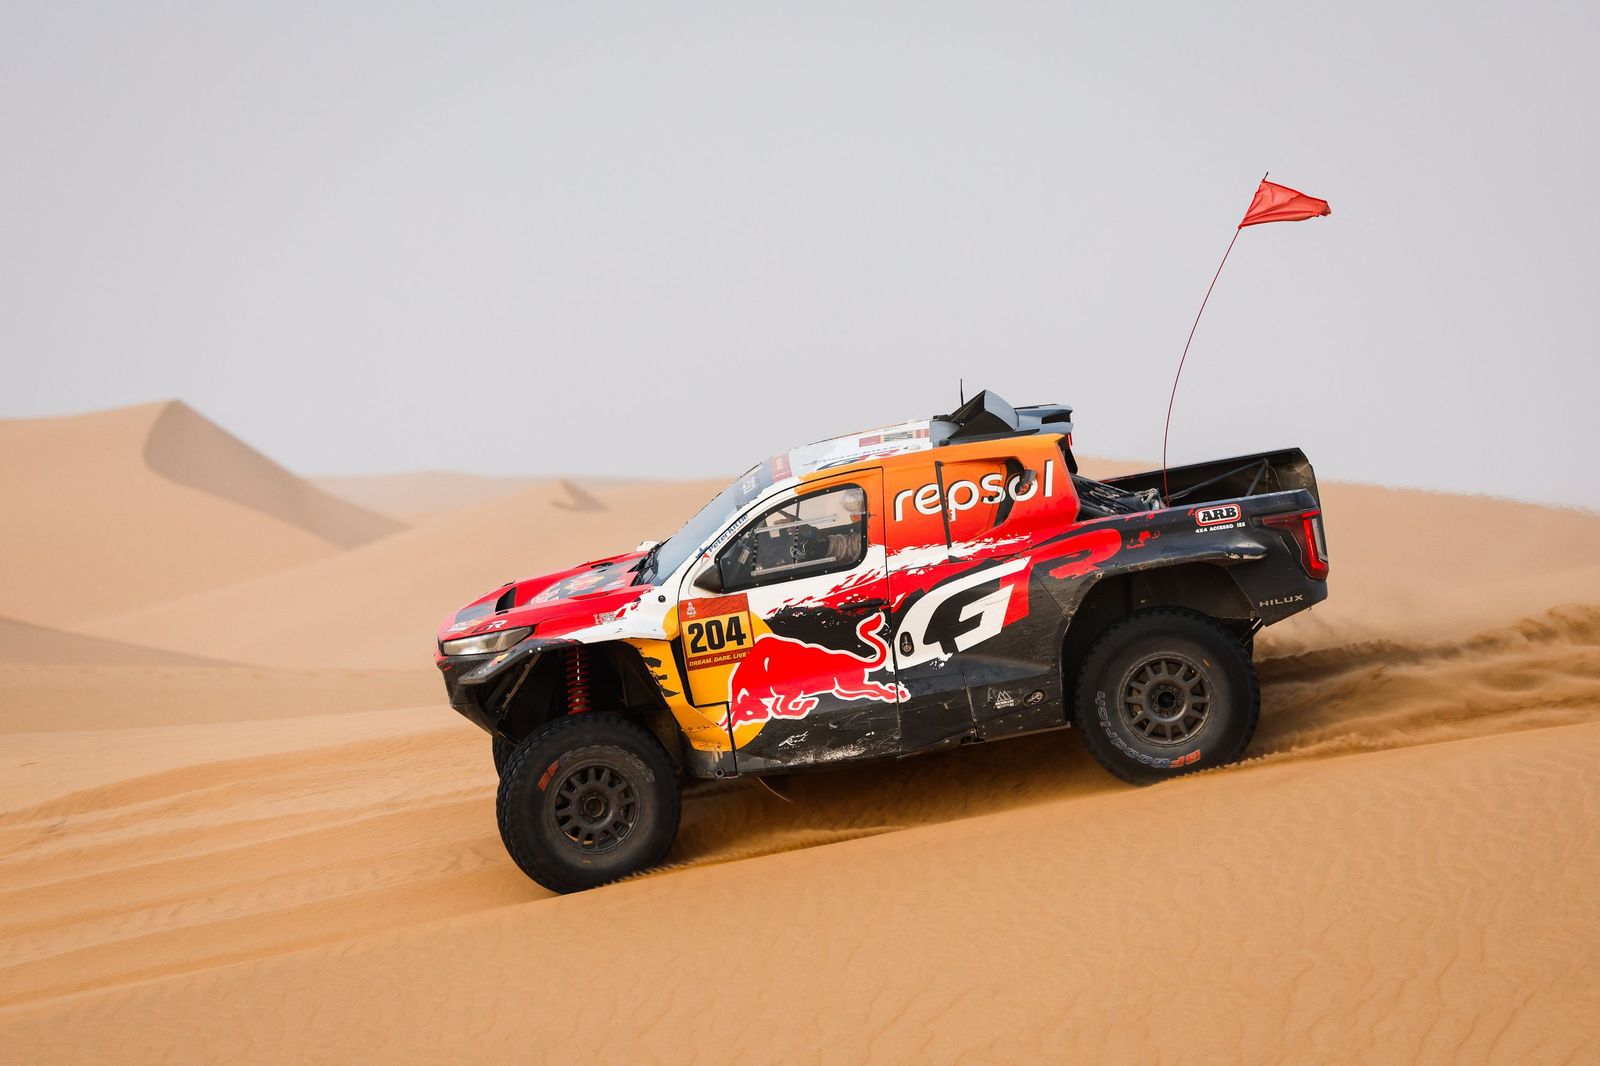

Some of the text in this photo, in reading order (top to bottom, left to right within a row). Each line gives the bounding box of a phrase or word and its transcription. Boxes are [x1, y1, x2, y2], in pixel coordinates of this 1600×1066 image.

[894, 460, 1053, 522] repsol
[1201, 508, 1237, 522] ARB
[1209, 522, 1246, 531] ACCESSOIES
[1259, 595, 1304, 607] HILUX
[688, 616, 747, 654] 204
[689, 659, 713, 667] DREAM.
